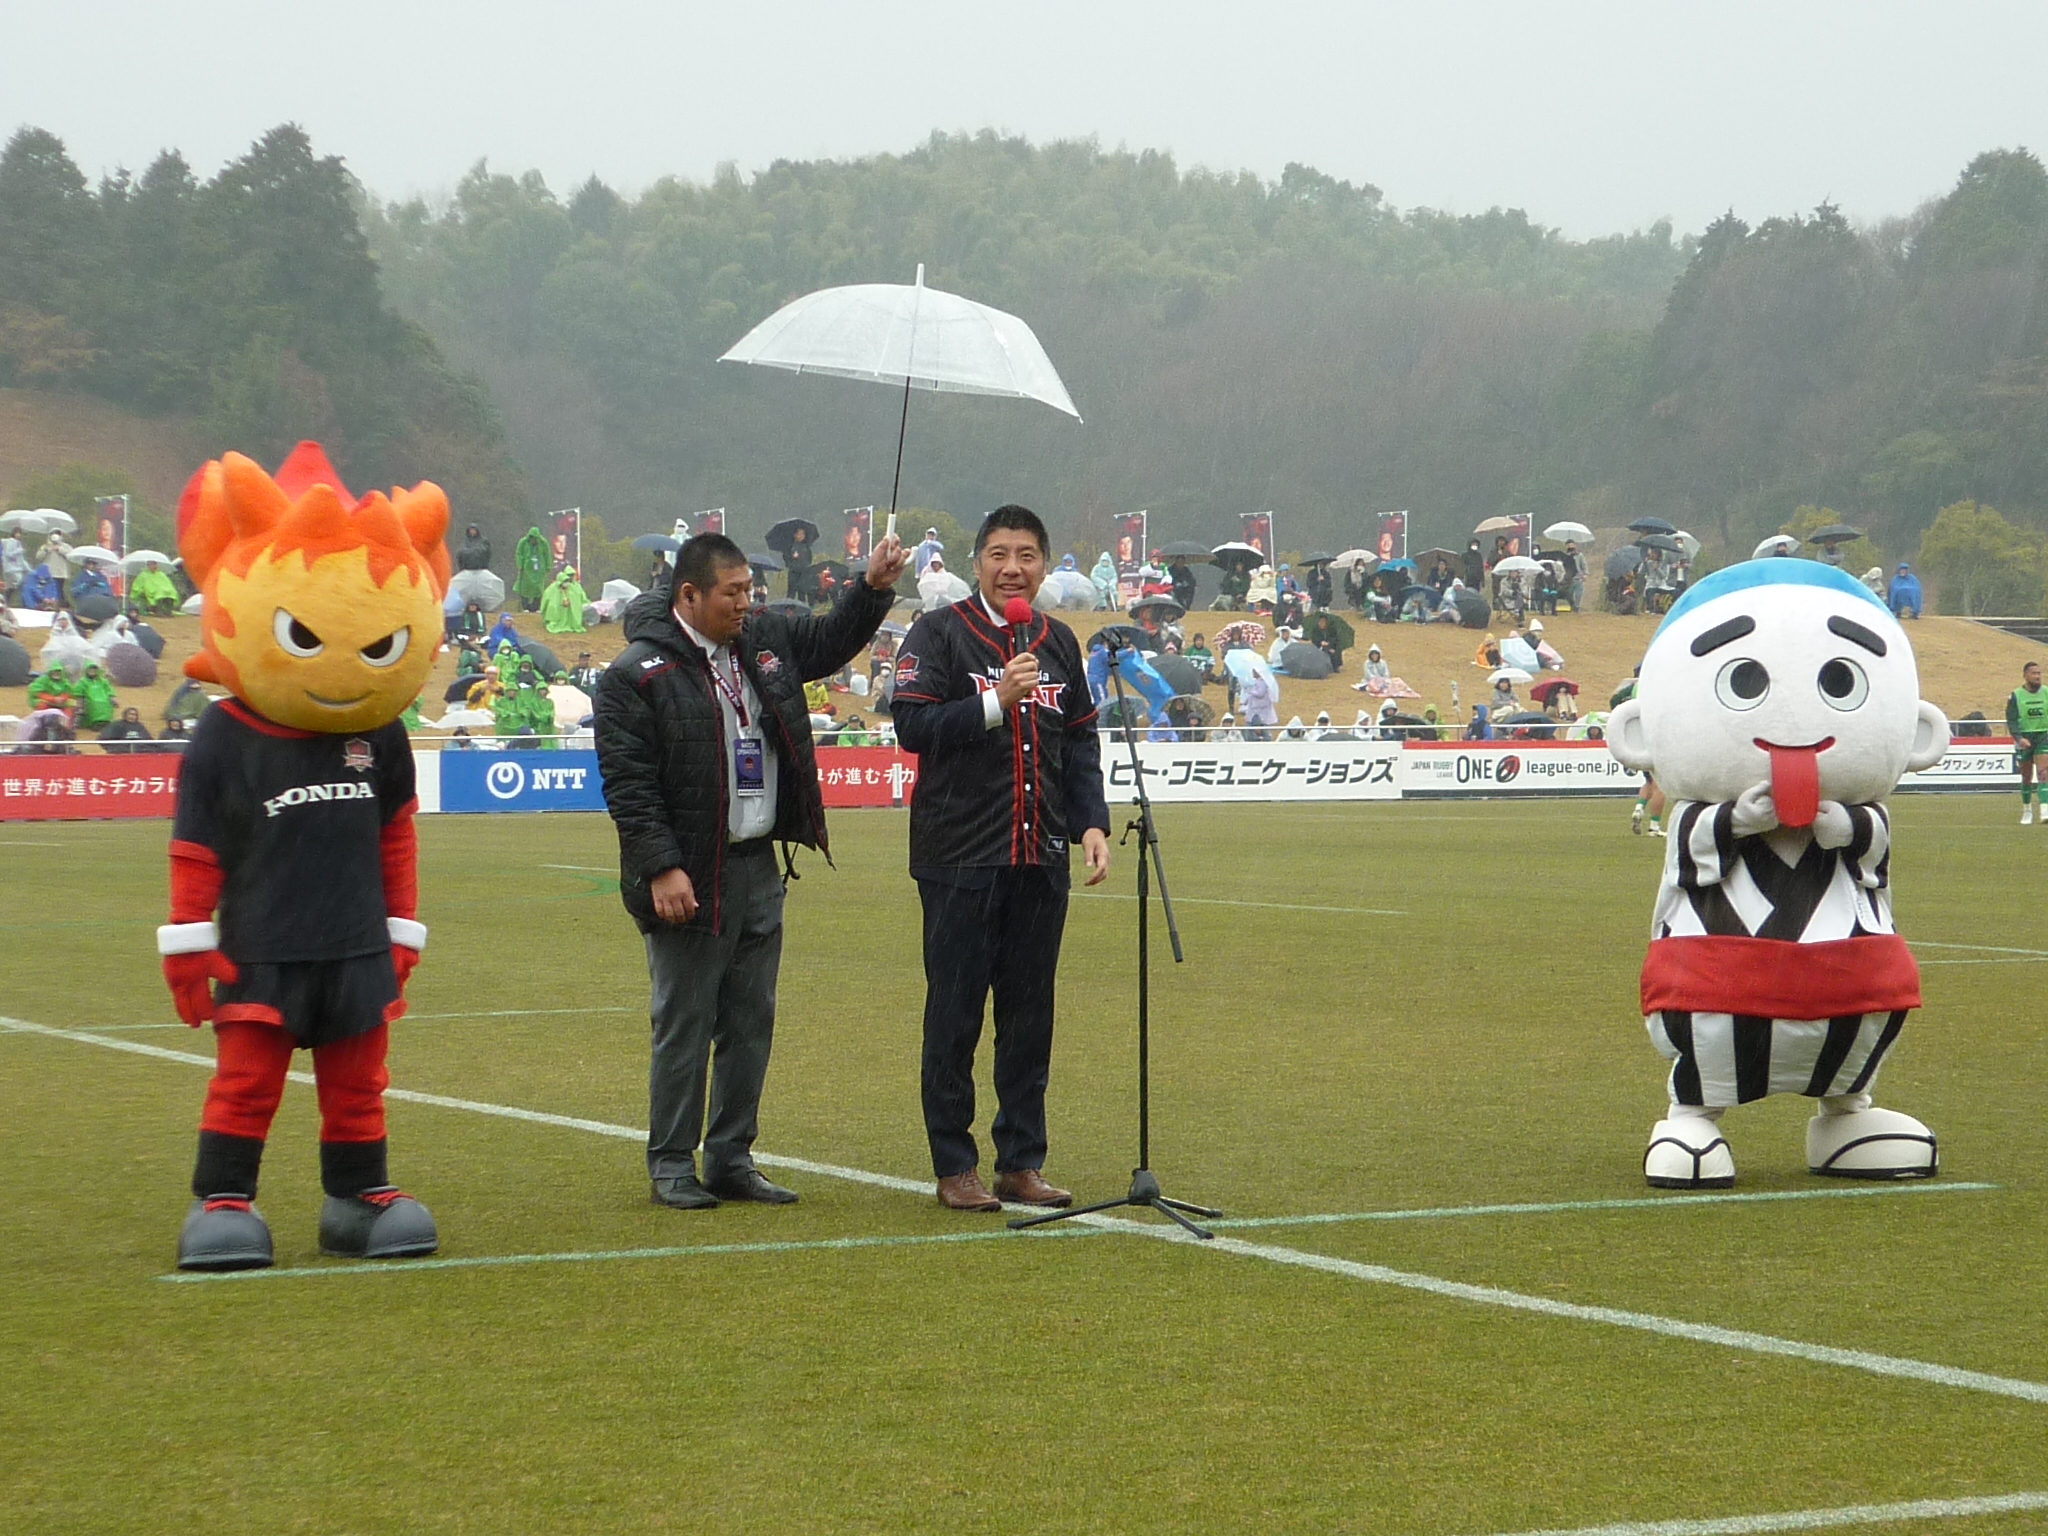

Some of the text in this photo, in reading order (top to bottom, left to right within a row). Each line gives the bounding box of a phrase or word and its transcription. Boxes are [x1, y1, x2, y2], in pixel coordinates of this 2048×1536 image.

[968, 673, 1066, 714] HAT
[532, 768, 587, 790] NTT
[1109, 758, 1394, 786] ヒト・コミュニケーションズ
[1411, 760, 1431, 770] JAPAN
[1456, 755, 1493, 784] ONE
[1526, 759, 1619, 777] league-one.jp
[263, 782, 376, 817] HONDA
